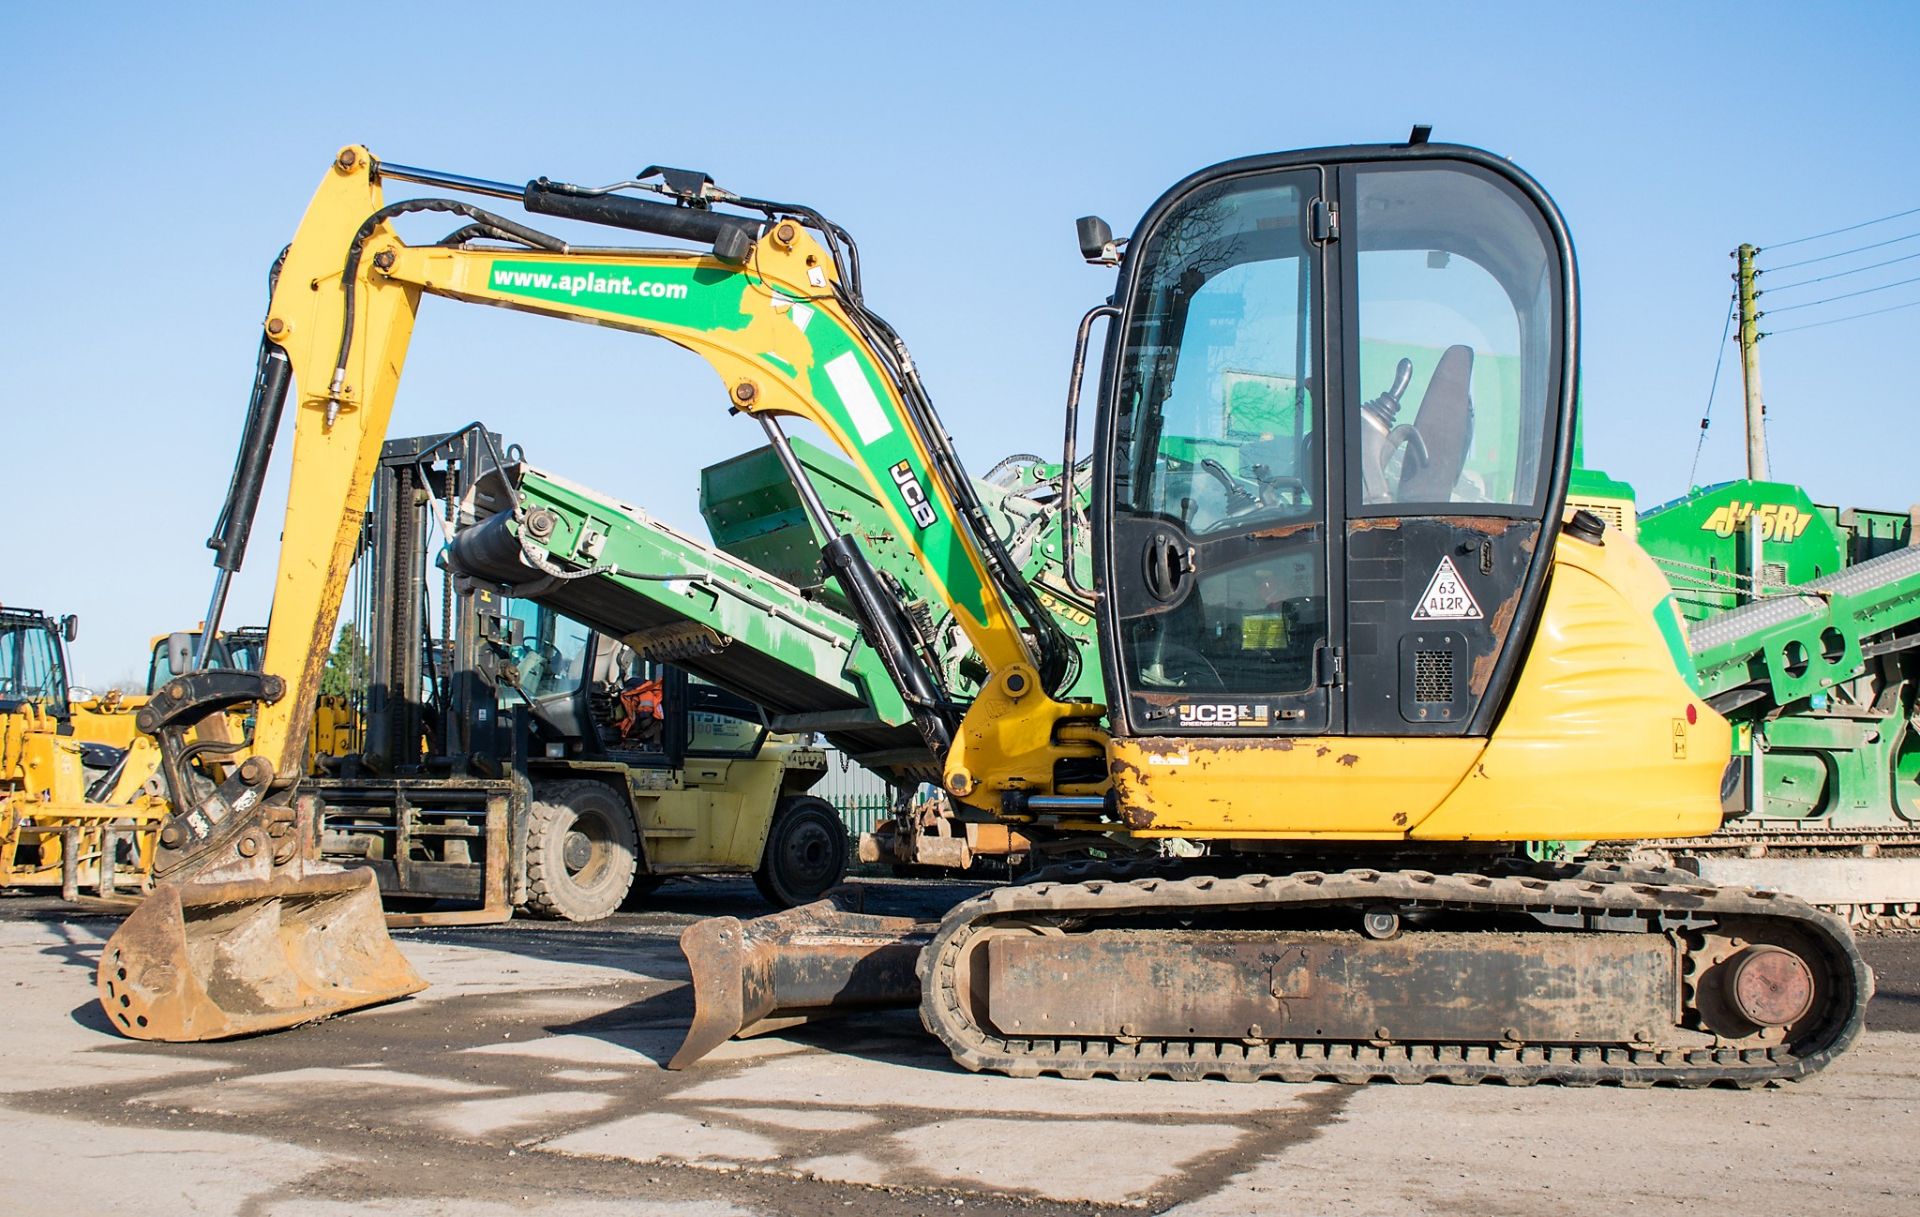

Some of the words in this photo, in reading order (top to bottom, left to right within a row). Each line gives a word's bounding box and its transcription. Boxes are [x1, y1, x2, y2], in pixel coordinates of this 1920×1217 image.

[494, 270, 688, 299] www.aplant.com
[890, 461, 936, 528] JCB
[1438, 582, 1455, 595] 63
[1179, 704, 1237, 721] JCB
